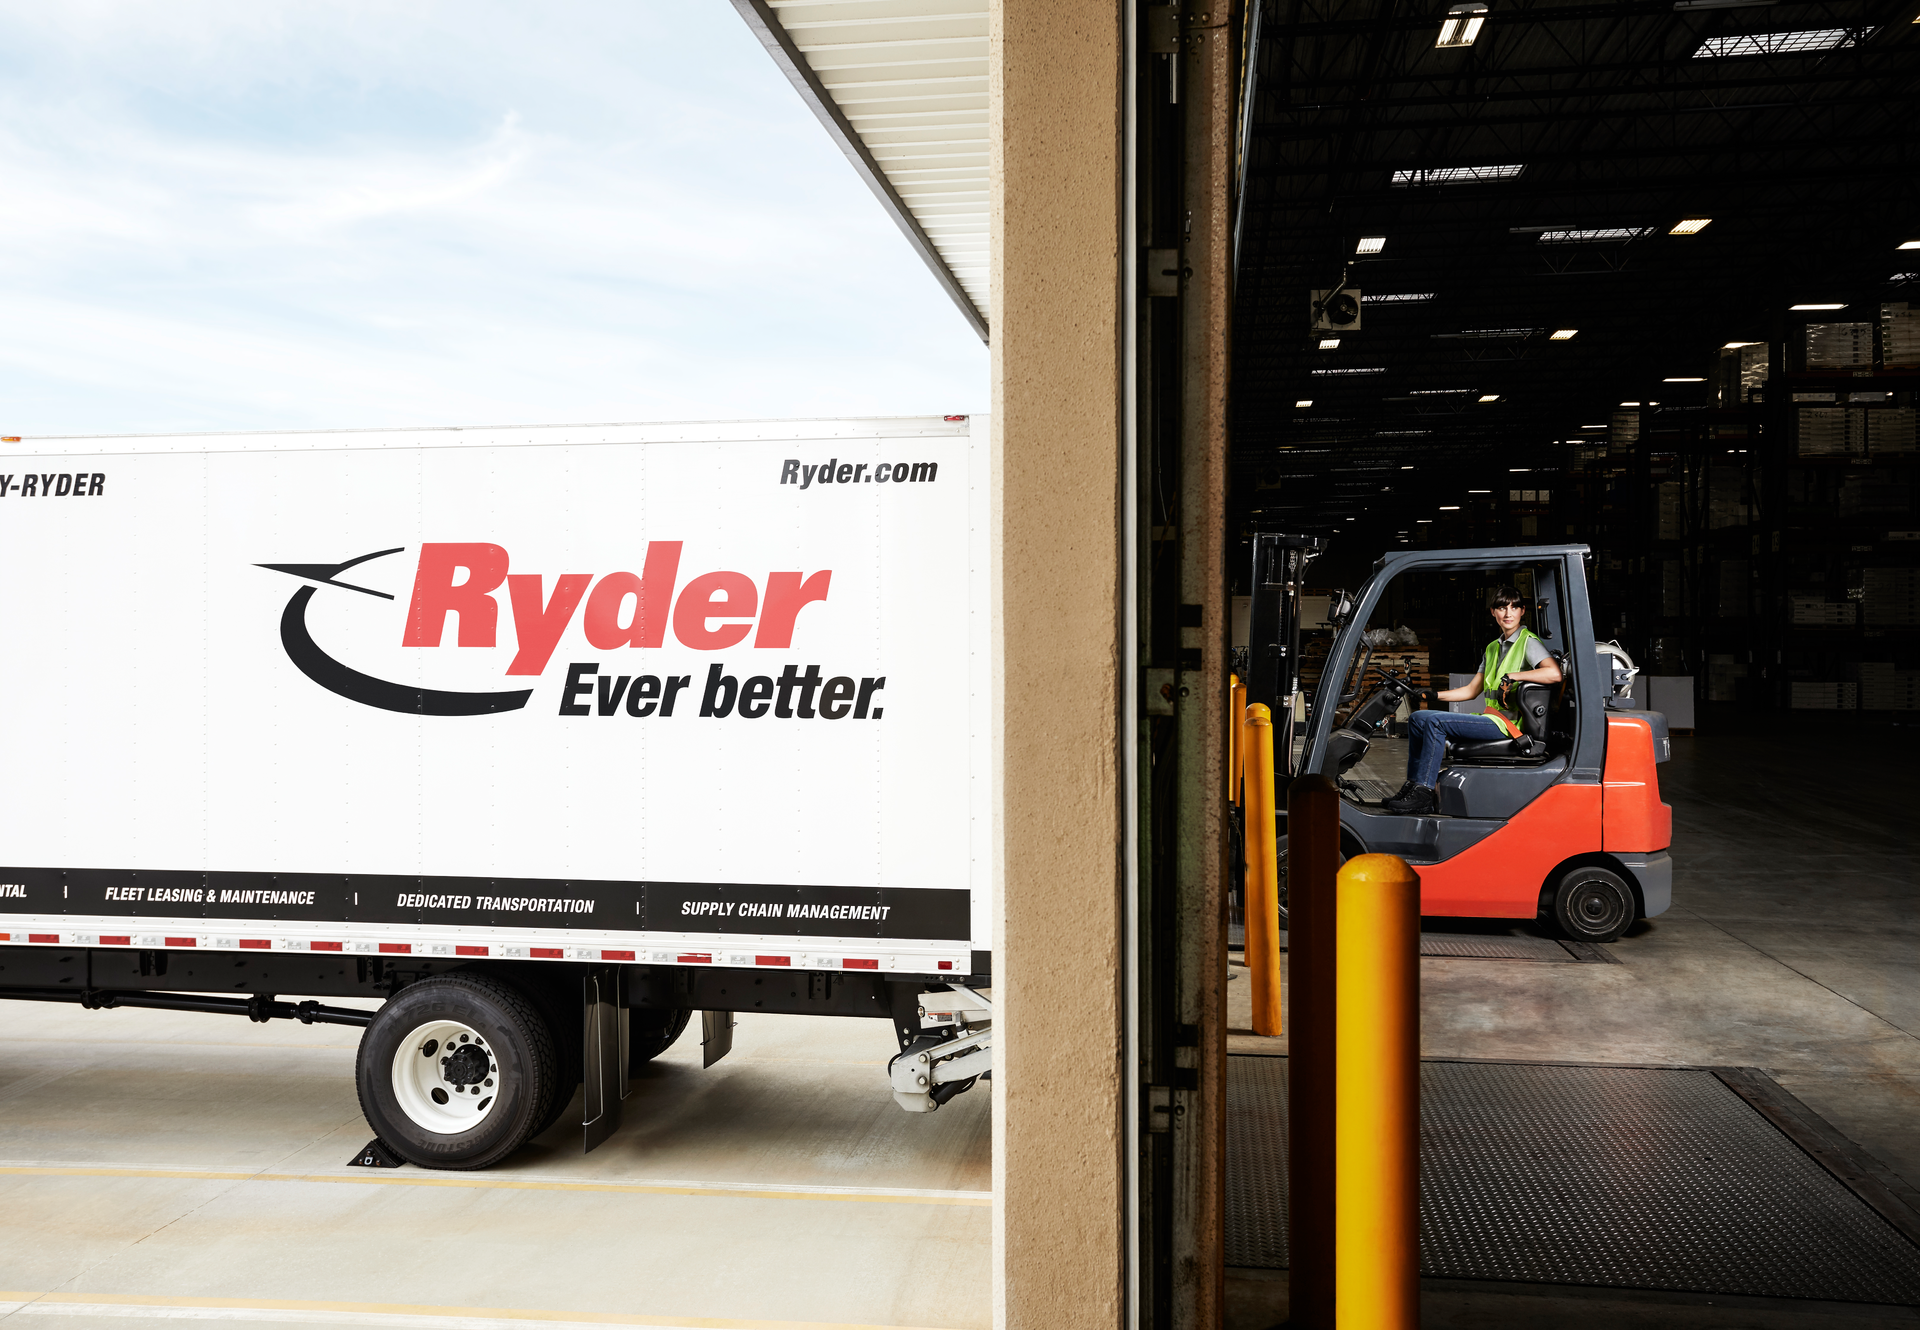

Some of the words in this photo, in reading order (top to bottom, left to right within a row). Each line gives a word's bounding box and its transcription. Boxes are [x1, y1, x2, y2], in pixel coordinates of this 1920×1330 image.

[0, 473, 105, 497] Y-RYDER
[781, 459, 938, 489] Ryder.com
[402, 541, 832, 675] Ryder
[559, 663, 691, 717] Ever
[699, 664, 887, 719] better.
[105, 887, 145, 901] FLEET
[147, 888, 203, 902] LEASING
[206, 889, 216, 903] &
[220, 890, 315, 904] MAINTENANCE
[397, 894, 471, 909] DEDICATED
[475, 896, 595, 913] TRANSPORTATION
[682, 902, 735, 916] SUPPLY
[738, 903, 783, 917] CHAIN
[787, 904, 890, 920] MANAGEMENT
